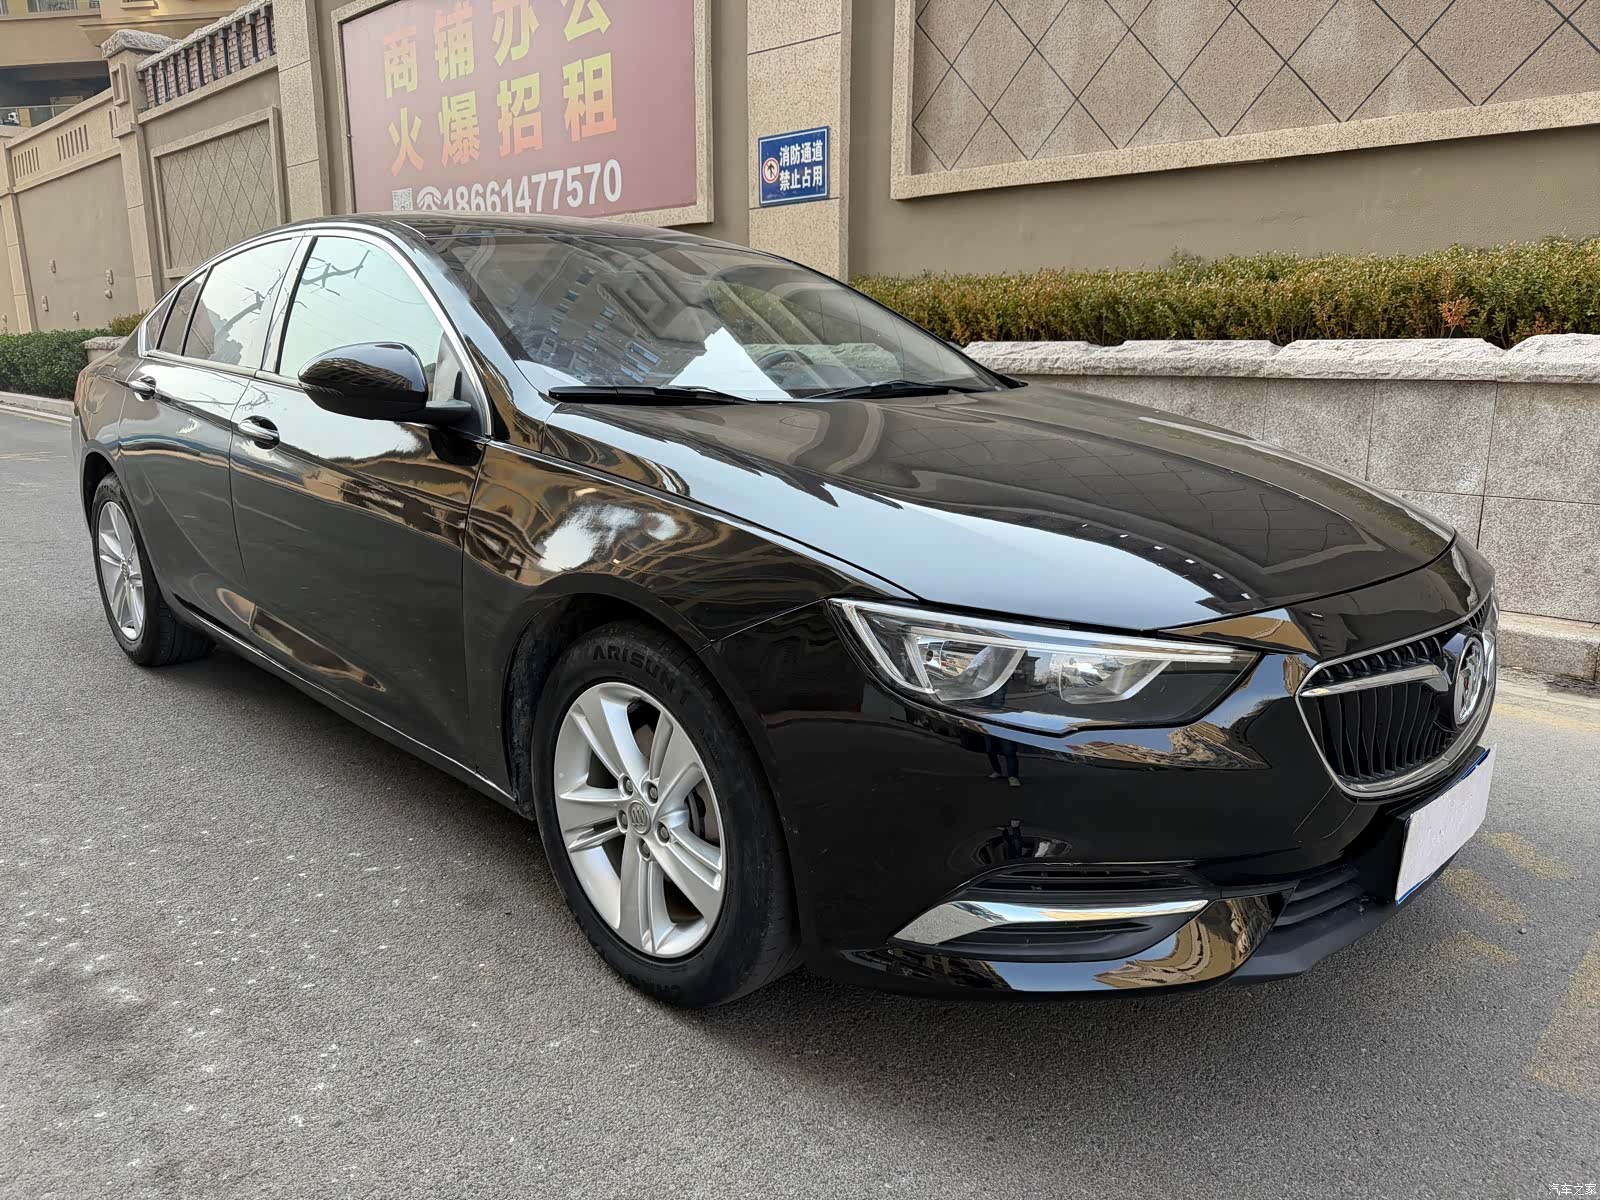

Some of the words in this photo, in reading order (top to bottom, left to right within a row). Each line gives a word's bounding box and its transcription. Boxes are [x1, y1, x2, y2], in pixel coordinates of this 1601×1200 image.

[388, 52, 617, 177] 火爆招租
[779, 139, 823, 167] 消防通道
[443, 159, 622, 213] 18661477570
[779, 165, 823, 191] 禁止占用
